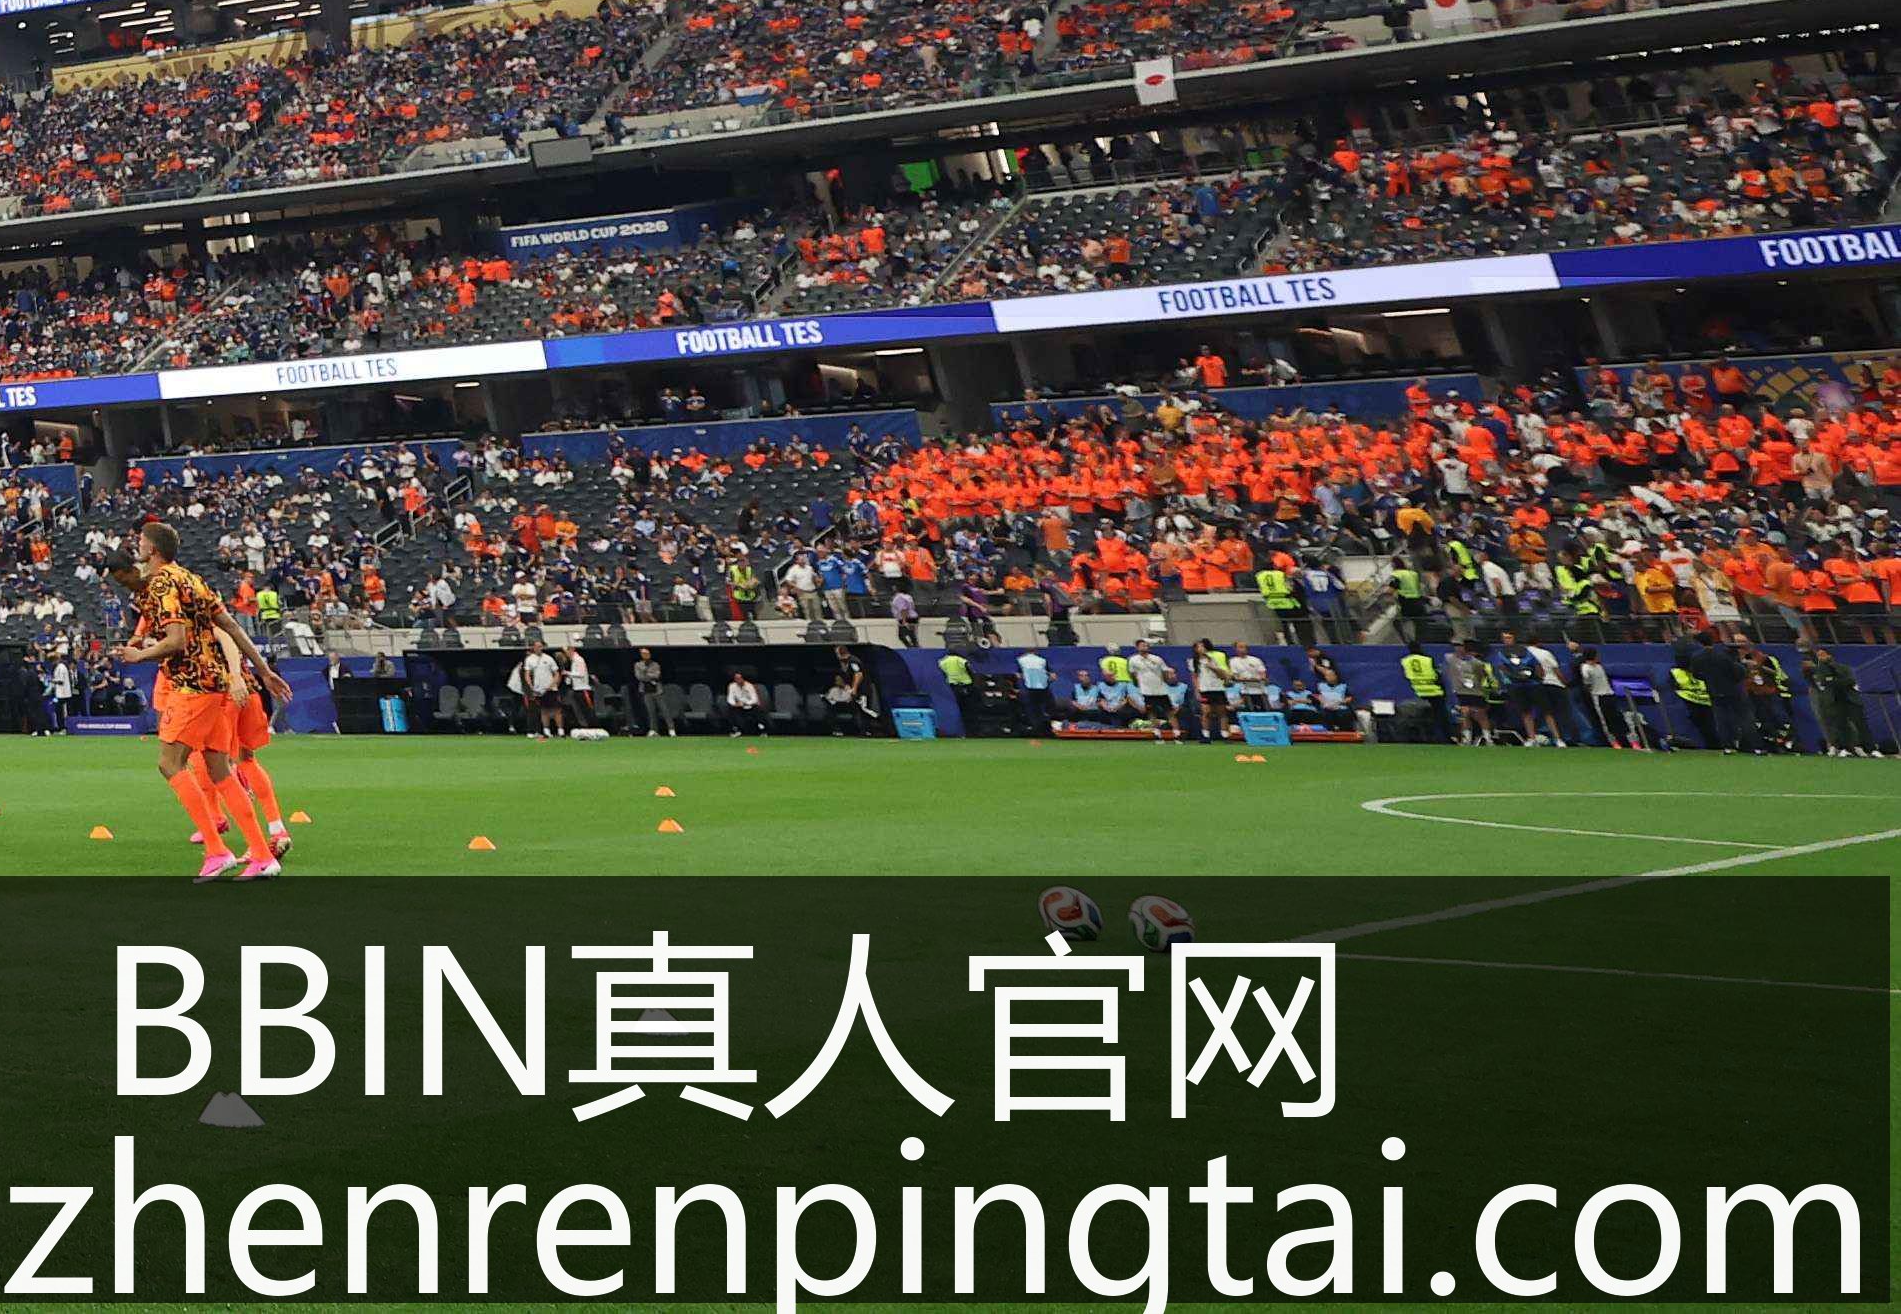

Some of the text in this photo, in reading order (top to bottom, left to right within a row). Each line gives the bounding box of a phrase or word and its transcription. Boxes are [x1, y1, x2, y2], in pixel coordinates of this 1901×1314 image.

[511, 220, 670, 247] FIFA WORLD CUP 2026
[1159, 282, 1284, 313] FOOTBALL
[676, 325, 782, 356] FOOTBALL
[276, 361, 363, 386] FOOTBALL
